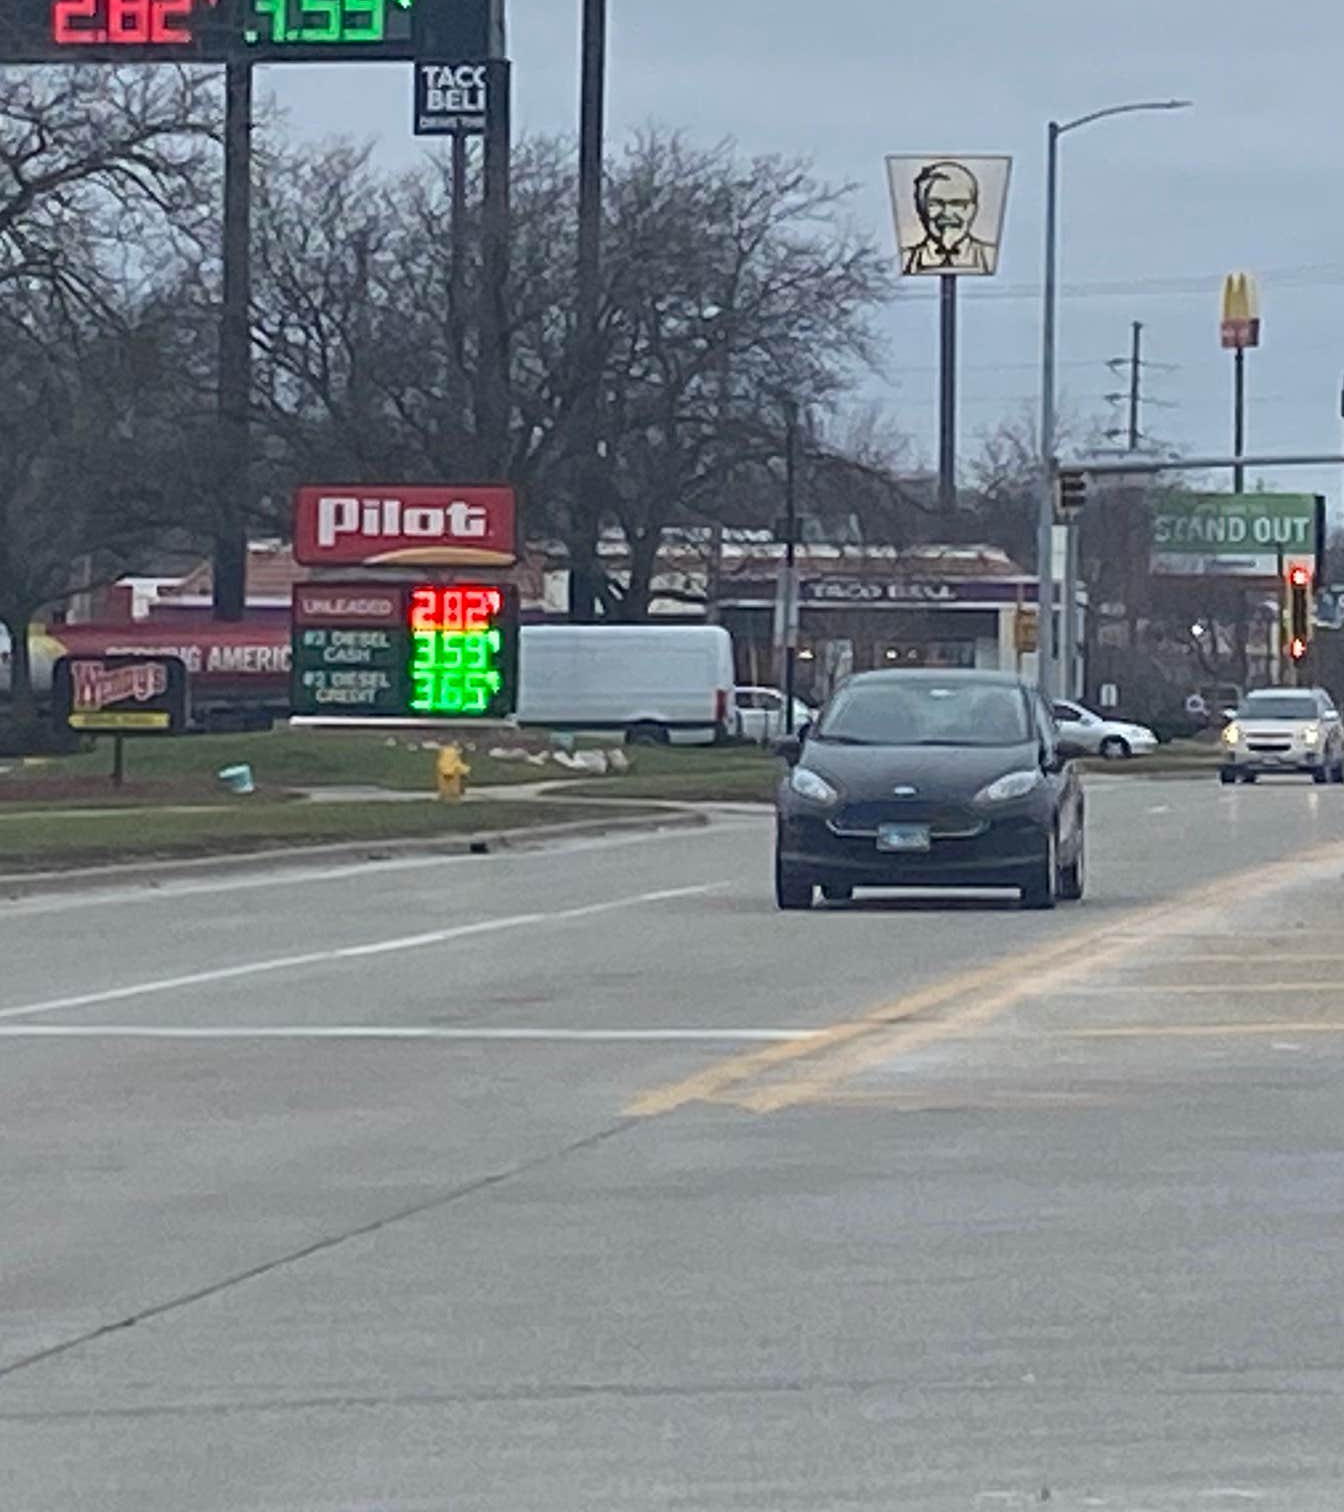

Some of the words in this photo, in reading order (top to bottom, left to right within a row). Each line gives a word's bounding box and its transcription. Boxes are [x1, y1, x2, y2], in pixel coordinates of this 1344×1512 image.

[317, 496, 487, 547] Pilot
[1253, 516, 1310, 543] OUT
[303, 597, 393, 615] UNLEADED
[331, 630, 391, 648] DIESEL
[323, 646, 371, 662] CASH
[331, 671, 391, 688] DIESEL
